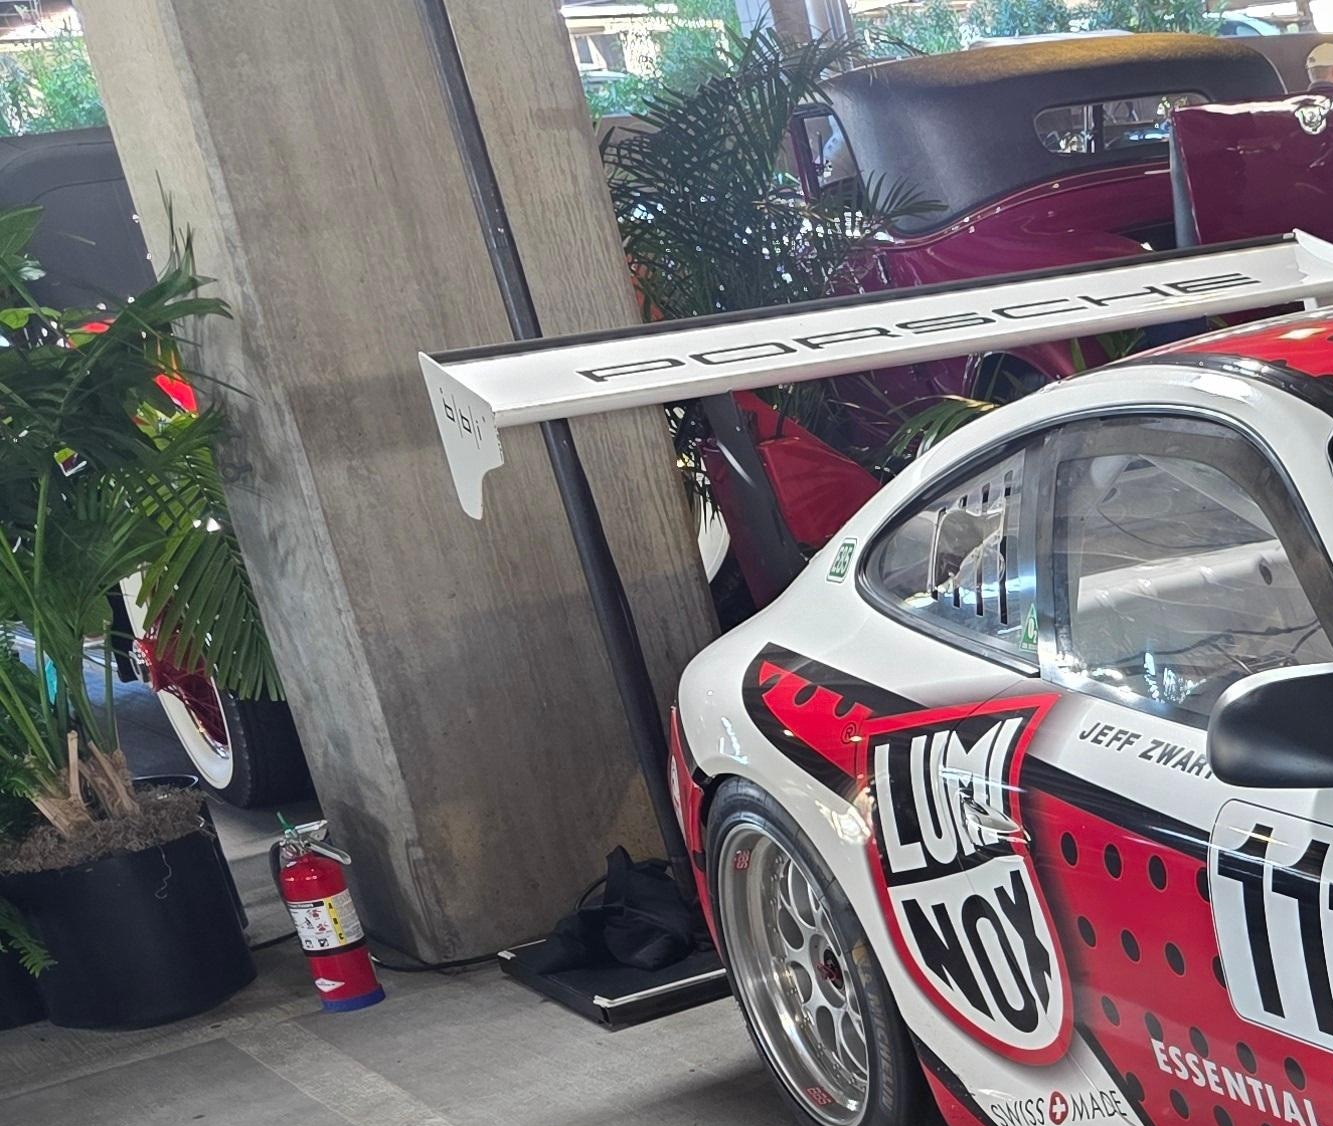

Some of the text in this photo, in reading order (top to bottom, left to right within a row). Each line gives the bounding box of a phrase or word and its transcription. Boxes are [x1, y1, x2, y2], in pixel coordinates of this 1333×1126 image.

[576, 270, 1262, 384] PORSCHE
[872, 715, 1024, 873] LUMI
[1079, 722, 1213, 779] JEFF ZWAR
[900, 868, 1052, 1034] NOX
[1070, 1089, 1129, 1123] MADE
